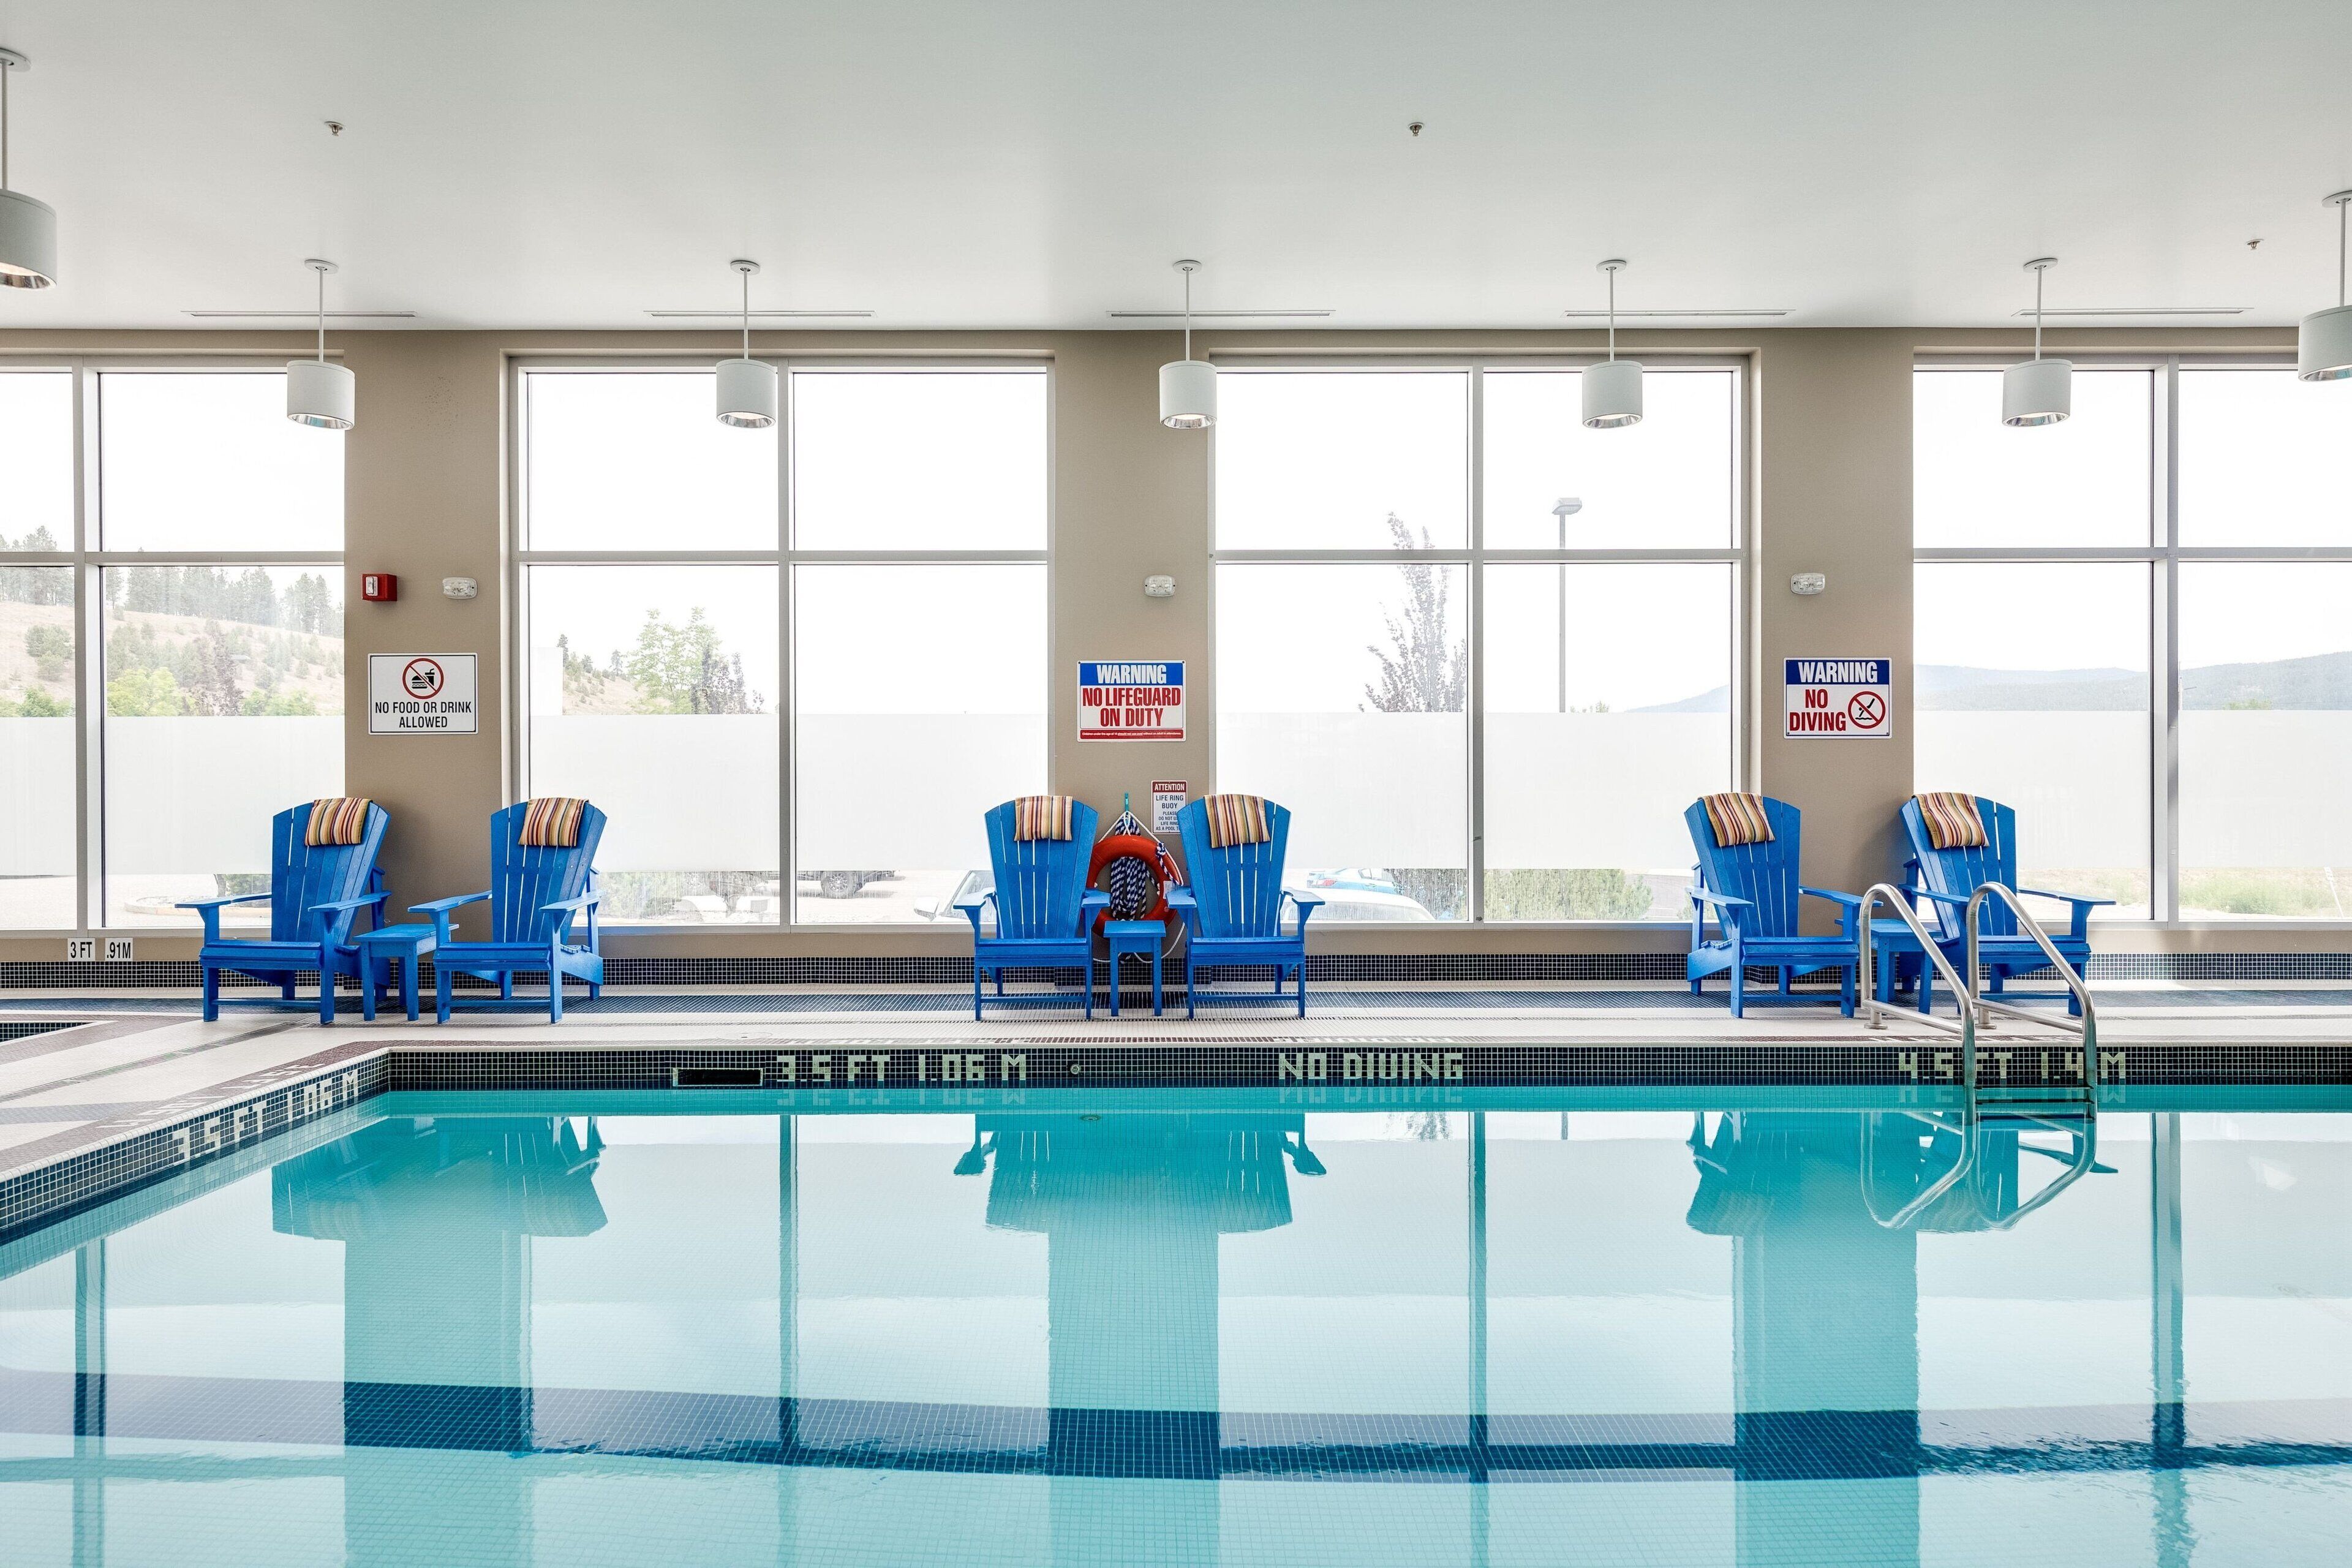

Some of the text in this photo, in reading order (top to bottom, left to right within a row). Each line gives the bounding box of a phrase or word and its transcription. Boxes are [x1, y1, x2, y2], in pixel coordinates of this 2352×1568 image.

[1096, 665, 1167, 684] WARNING
[1798, 662, 1878, 683] WARNING
[1082, 687, 1181, 707] NO LIFEGUARD
[1805, 689, 1828, 709] NO
[375, 701, 472, 714] NO FOOD OR DRINK
[1100, 708, 1164, 727] ON DUTY
[399, 716, 448, 728] ALLOWED
[1790, 712, 1846, 731] DIVING
[70, 941, 92, 959] 3 FT
[777, 1054, 1027, 1082] 3.5 FT 1.06 M
[1278, 1053, 1463, 1080] NO DIVING
[1899, 1052, 1953, 1079] 4.5
[2041, 1052, 2084, 1079] 1.4
[2101, 1052, 2125, 1079] M
[233, 1102, 267, 1144] FT
[342, 1069, 358, 1101] M
